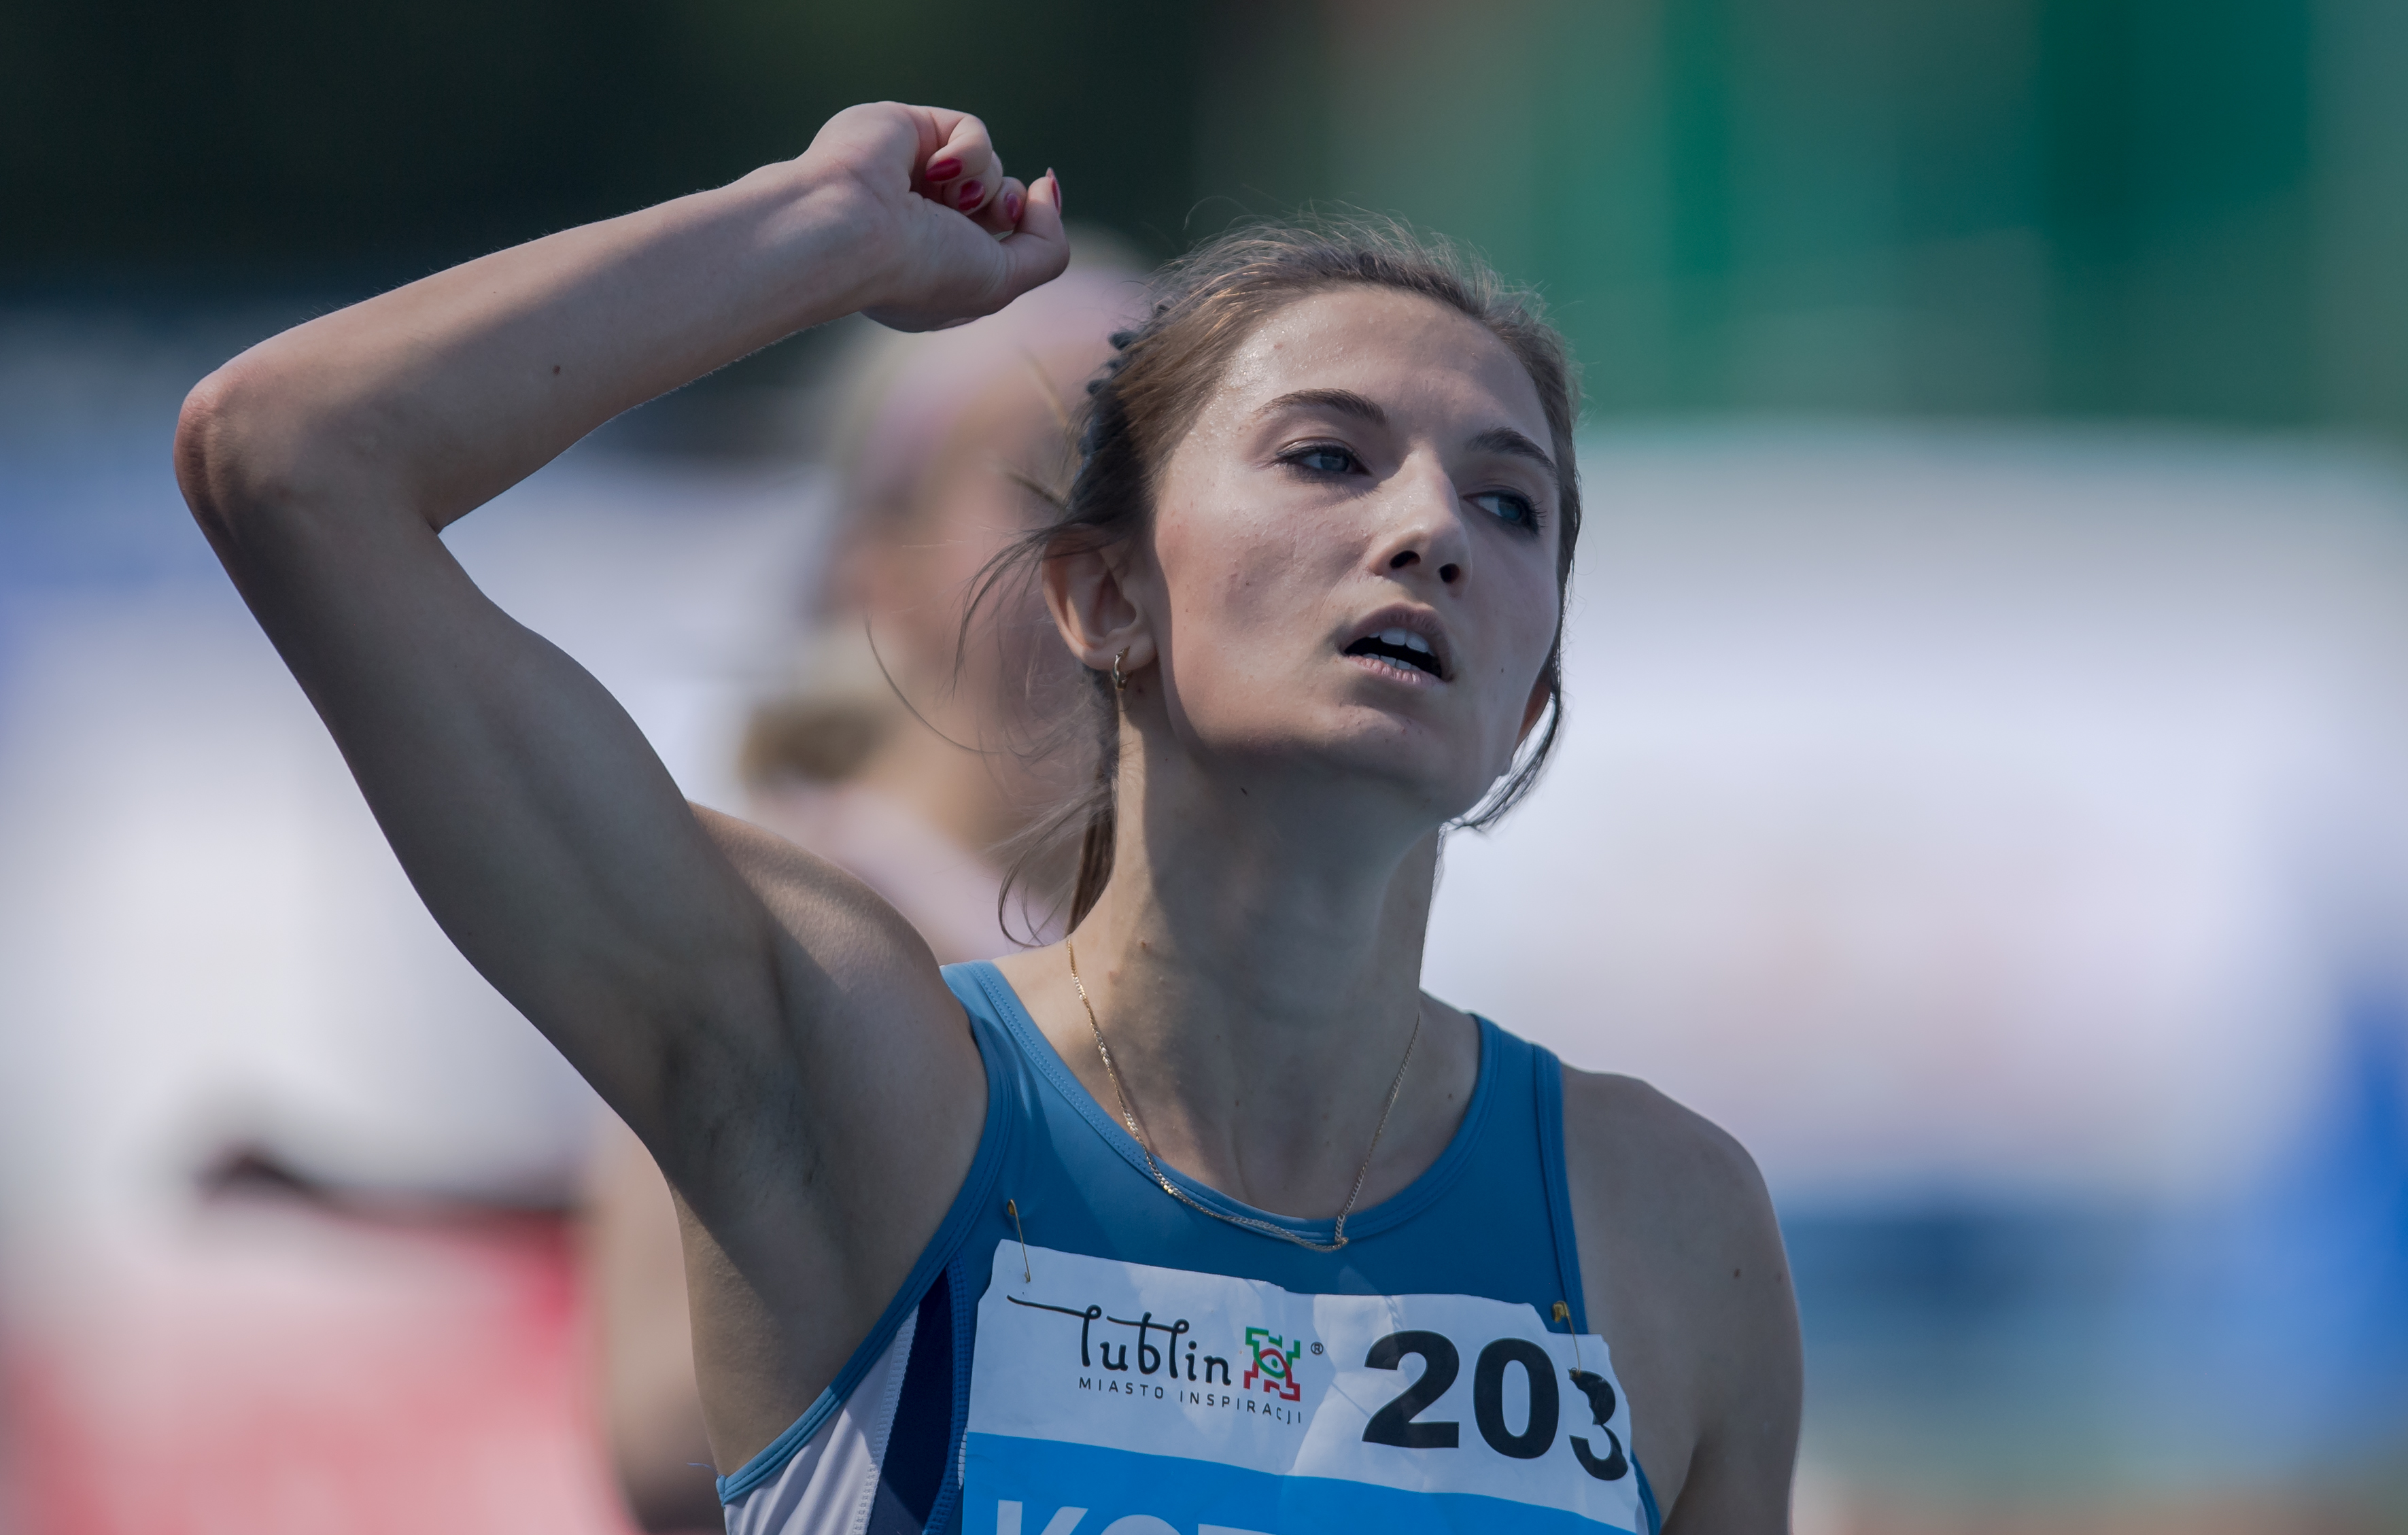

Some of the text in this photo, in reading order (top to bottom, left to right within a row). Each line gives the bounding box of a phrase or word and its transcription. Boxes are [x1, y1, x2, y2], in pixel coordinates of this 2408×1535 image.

[1078, 1376, 1301, 1425] MIASTO INSPIRACJI
[1361, 1329, 1630, 1481] 203
